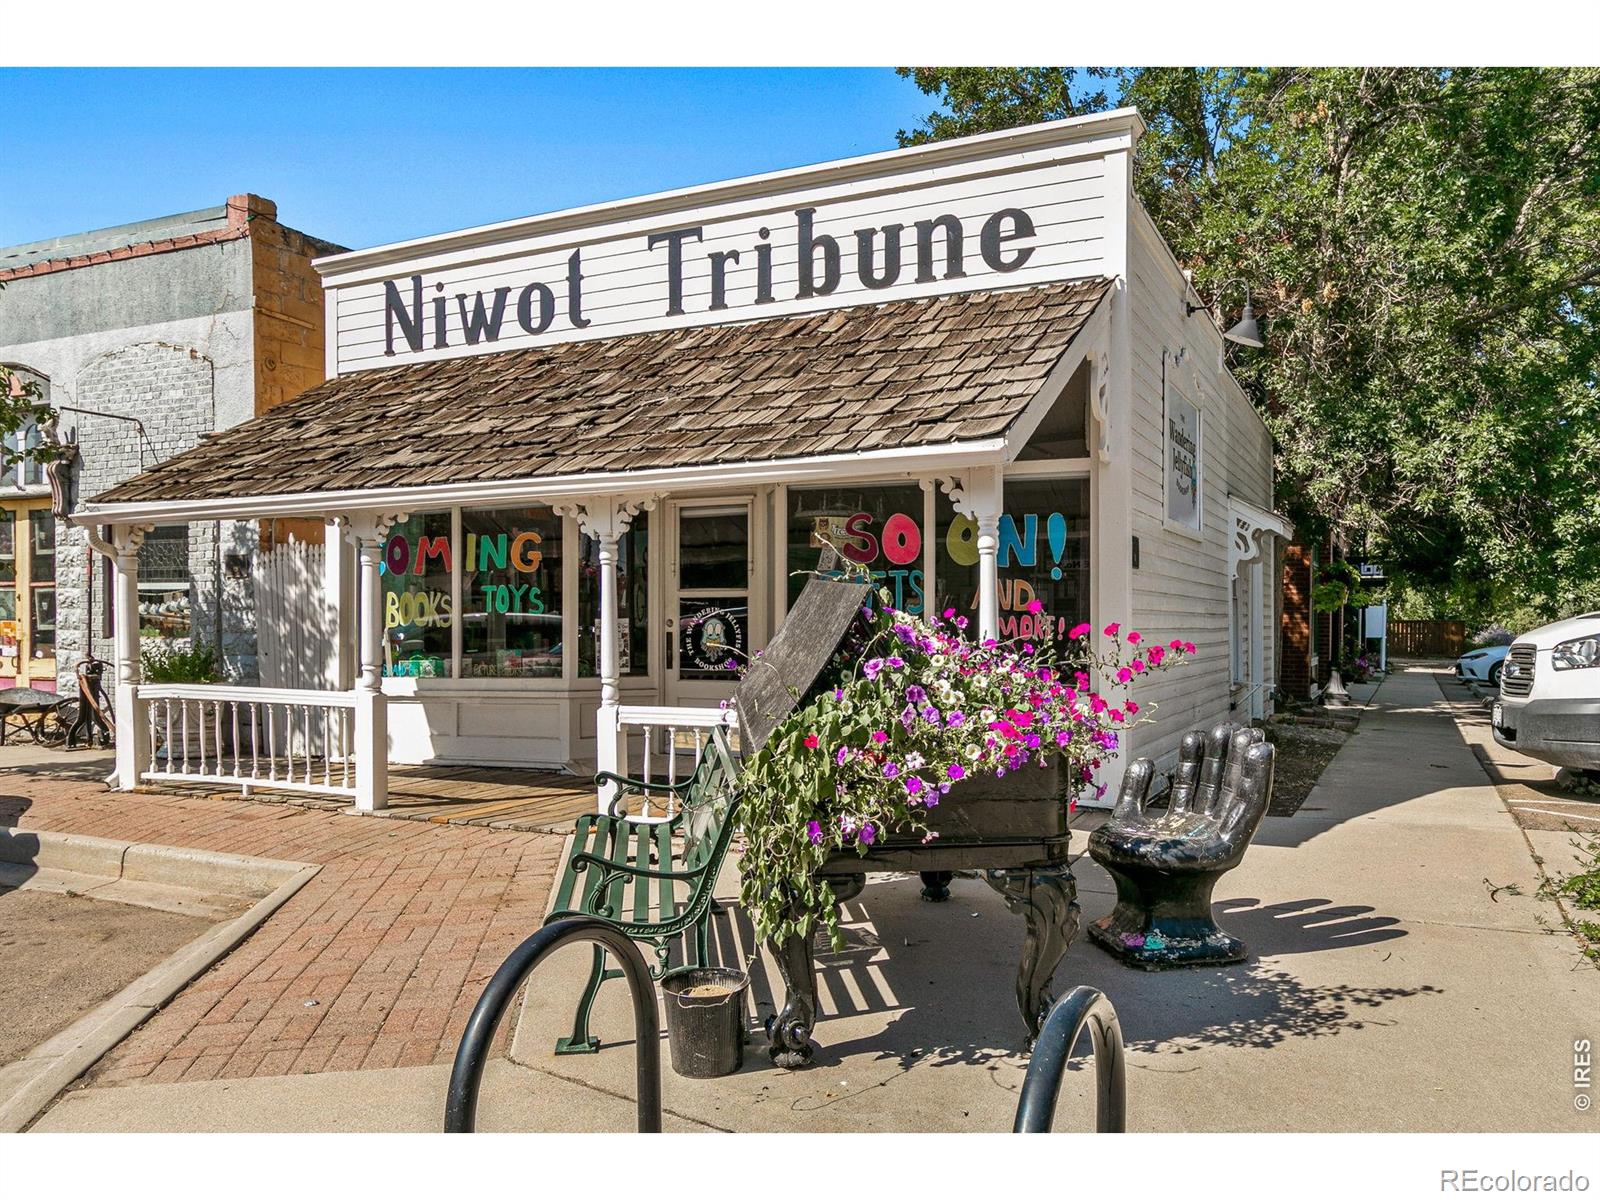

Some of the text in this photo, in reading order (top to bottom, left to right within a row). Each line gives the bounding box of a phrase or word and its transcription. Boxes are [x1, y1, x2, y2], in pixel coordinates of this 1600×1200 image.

[383, 206, 1037, 356] Niwot Tribune
[379, 532, 543, 576] OMING
[385, 591, 453, 629] BOOKS
[481, 584, 545, 615] TOYS
